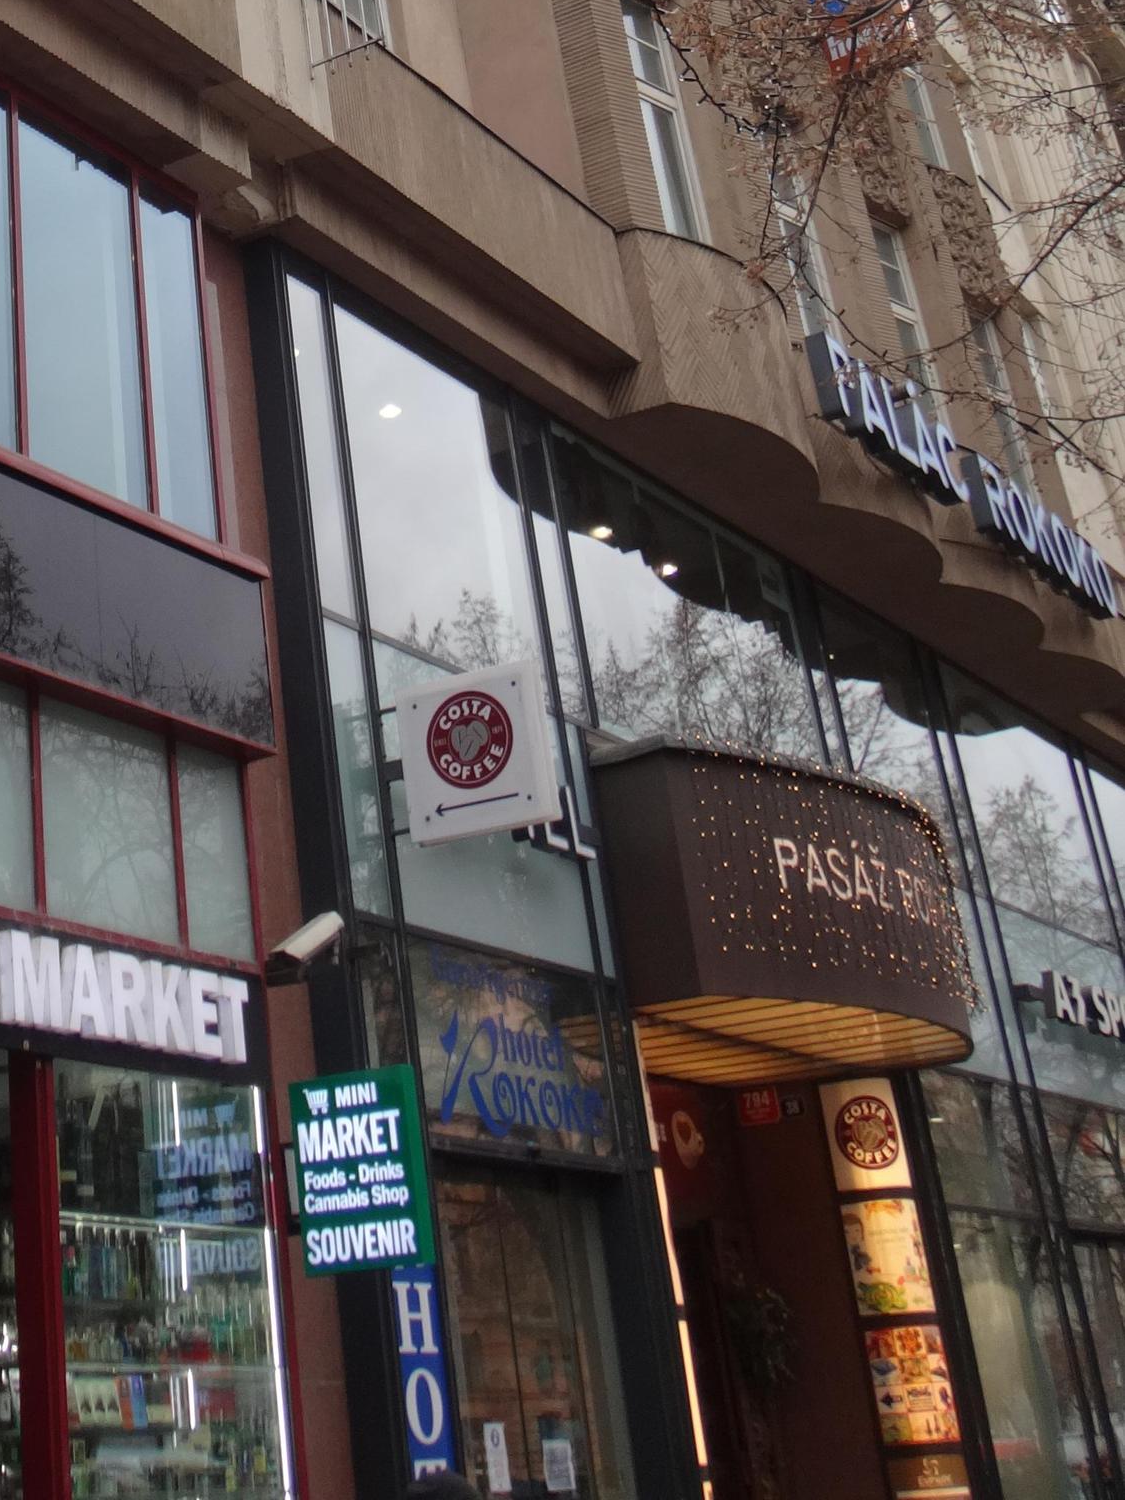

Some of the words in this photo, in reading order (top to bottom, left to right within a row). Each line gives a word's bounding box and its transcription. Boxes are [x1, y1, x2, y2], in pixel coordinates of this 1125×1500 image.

[976, 453, 1118, 618] ROKOKO
[439, 700, 492, 731] COSTA
[440, 743, 504, 781] COFFEE
[497, 1013, 565, 1071] hotel
[334, 1081, 379, 1109] MINI
[843, 1102, 887, 1124] COSTA
[297, 1108, 400, 1164] MARKET
[846, 1138, 897, 1164] COFFEE
[303, 1167, 347, 1192] Foods
[358, 1160, 405, 1185] Drinks
[304, 1186, 370, 1214] Cannabis
[371, 1184, 409, 1208] Shop
[306, 1218, 417, 1266] SOUVENIR
